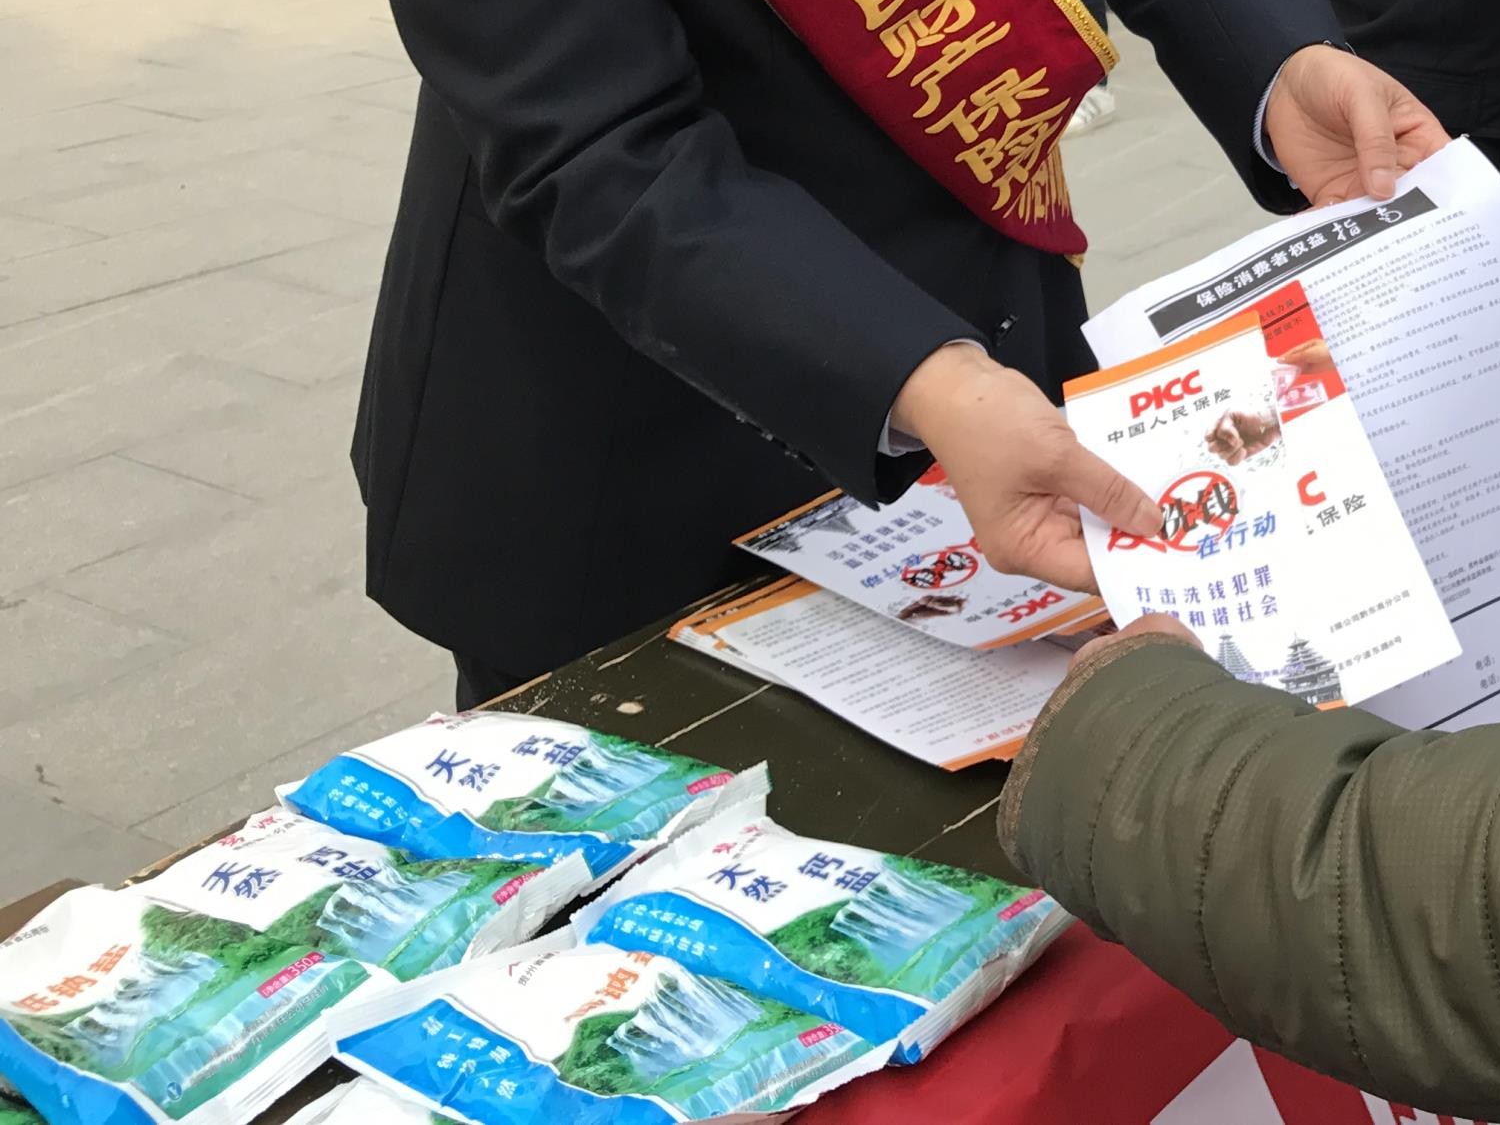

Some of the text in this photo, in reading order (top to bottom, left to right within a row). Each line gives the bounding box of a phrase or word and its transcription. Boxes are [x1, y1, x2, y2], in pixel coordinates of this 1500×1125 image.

[1196, 206, 1403, 309] 保险消费者权益指南
[1107, 387, 1232, 444] 中国人民保险
[1129, 369, 1204, 419] PICC
[1197, 510, 1277, 560] 在行动
[1306, 493, 1367, 536] 保险
[998, 590, 1066, 624] PICC
[1136, 564, 1273, 604] 打击洗钱犯罪
[424, 734, 587, 793] 天然钙盐
[201, 845, 383, 900] 天然钙盐
[706, 851, 881, 904] 天然钙盐
